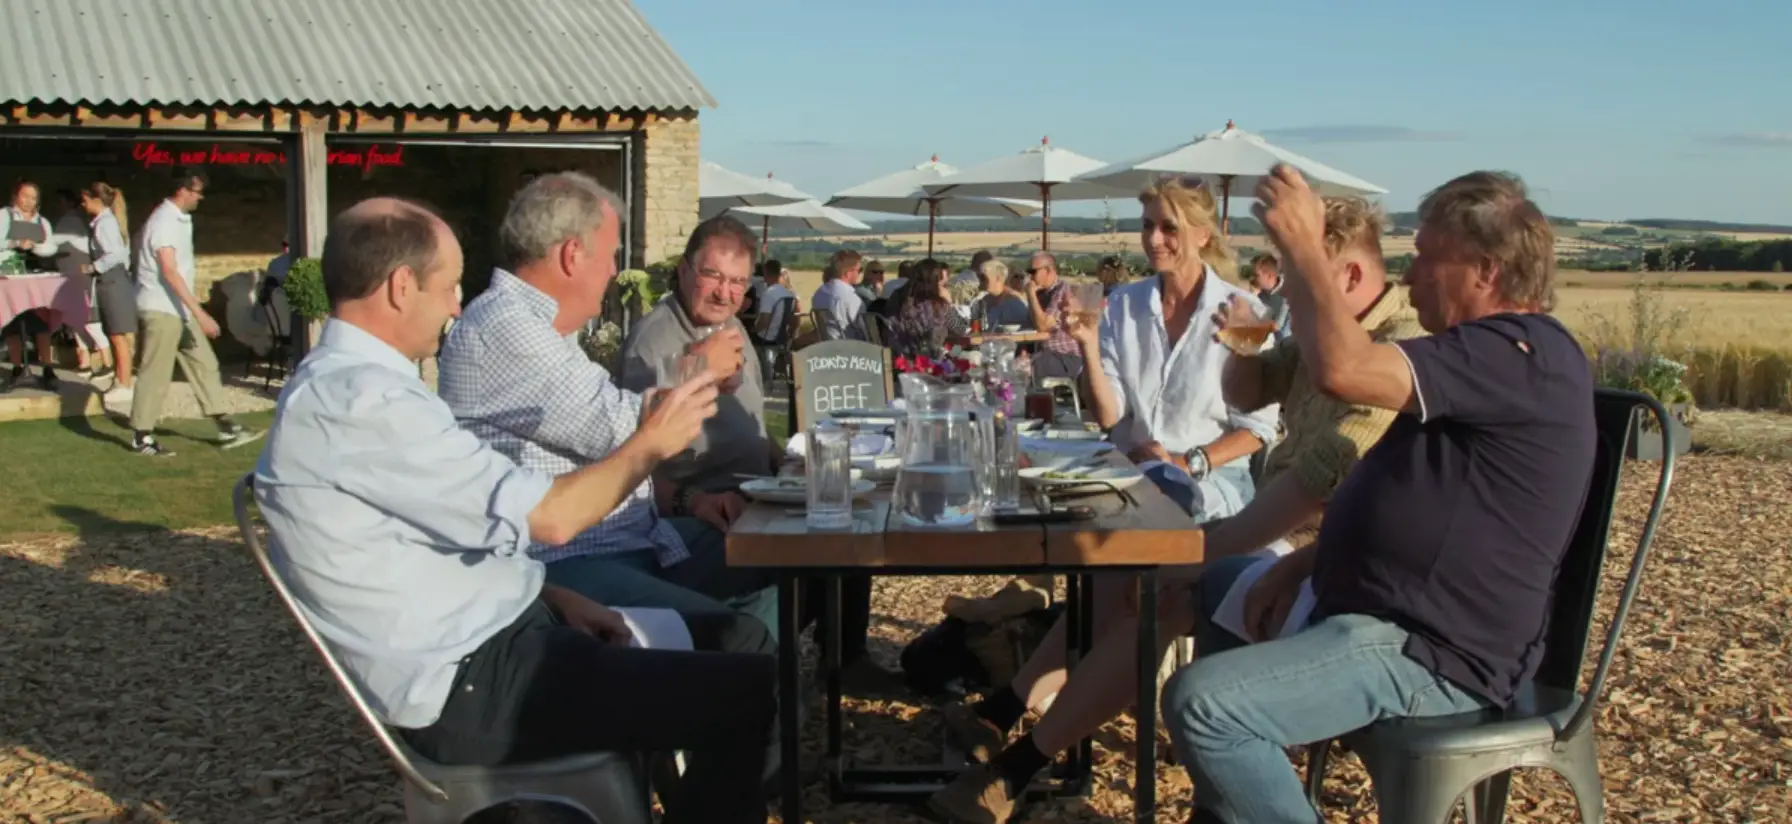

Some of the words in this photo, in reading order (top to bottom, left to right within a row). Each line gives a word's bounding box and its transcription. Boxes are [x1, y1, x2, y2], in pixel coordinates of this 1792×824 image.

[180, 151, 207, 164] we
[210, 143, 250, 165] have
[254, 151, 277, 165] no
[850, 355, 882, 373] MENU
[814, 383, 872, 412] BEEF
